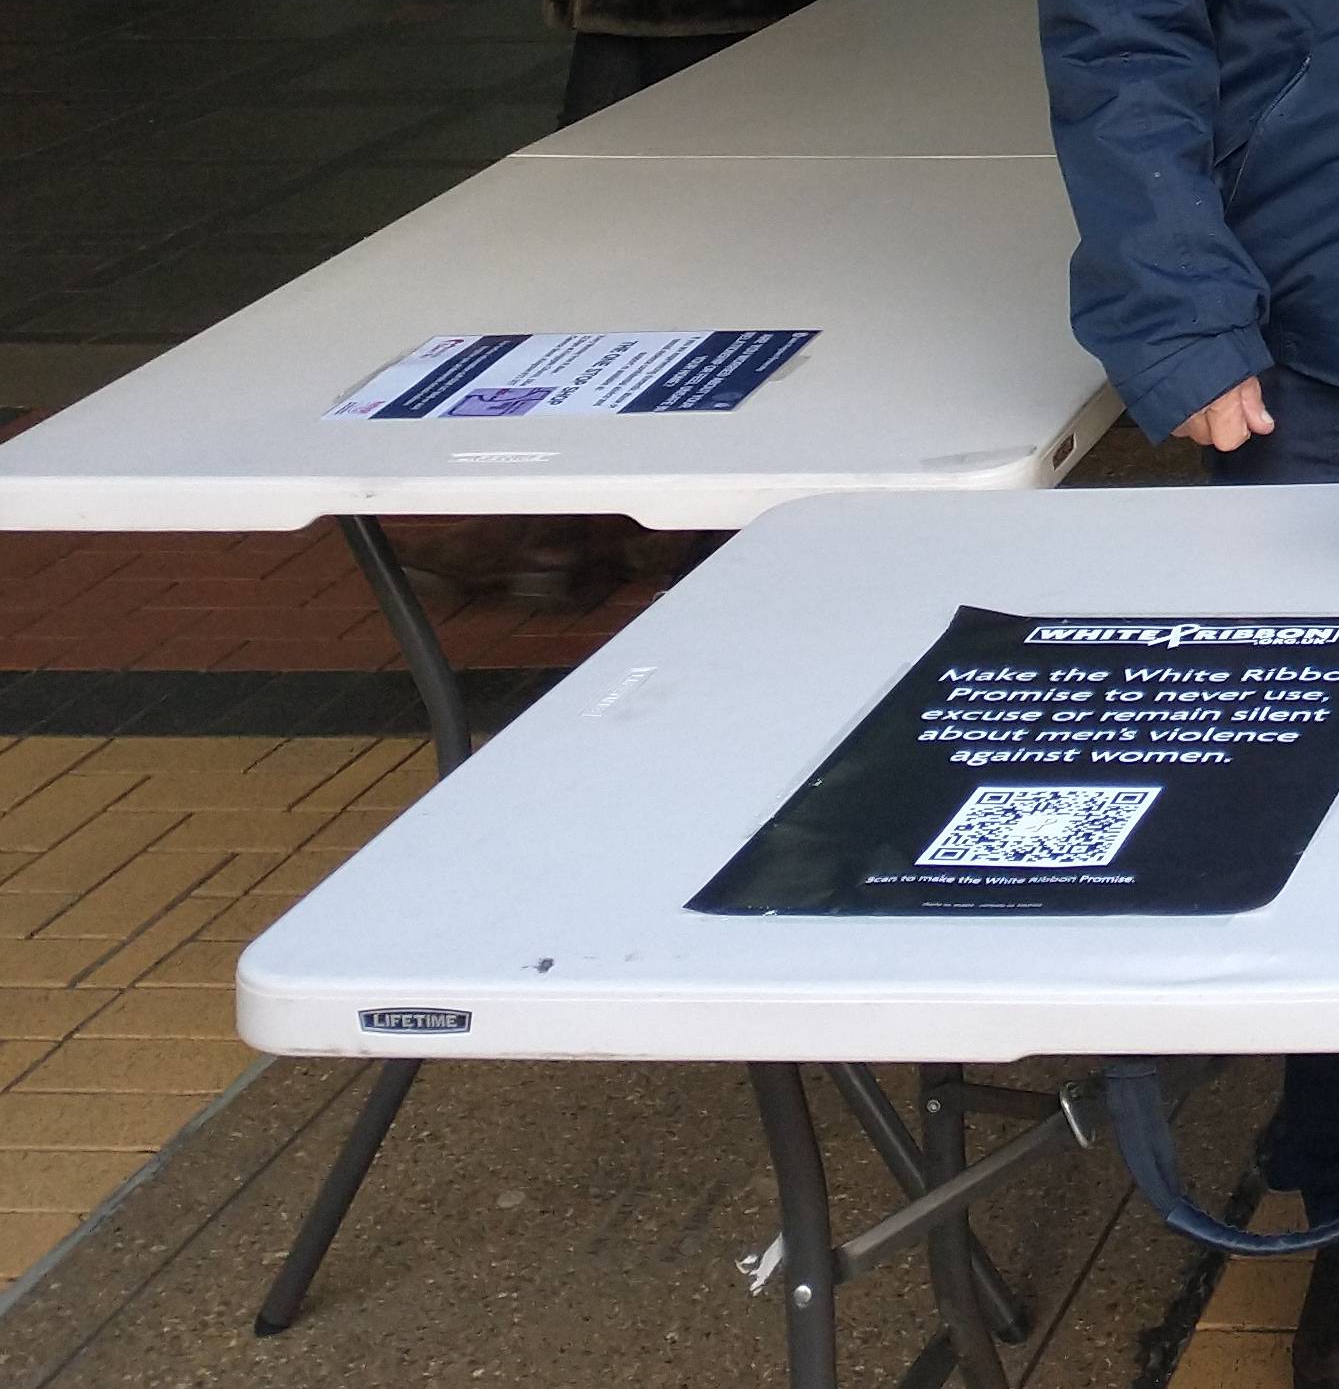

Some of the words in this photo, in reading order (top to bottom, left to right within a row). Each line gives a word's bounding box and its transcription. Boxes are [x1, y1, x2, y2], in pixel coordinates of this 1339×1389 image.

[607, 340, 639, 352] THE
[590, 353, 623, 366] ONE
[568, 368, 605, 385] STOP
[543, 386, 583, 405] SHOP
[1038, 629, 1159, 641] WHITE
[1193, 628, 1333, 642] RIBBON
[938, 669, 1037, 683] Make
[1049, 668, 1105, 683] the
[1124, 668, 1230, 683] White
[946, 688, 1093, 703] Promise
[1105, 688, 1144, 703] to
[1154, 689, 1256, 703] never
[1263, 689, 1331, 705] use,
[920, 709, 1043, 723] excuse
[1051, 710, 1095, 723] or
[1100, 707, 1220, 723] remain
[1230, 706, 1331, 723] silent
[918, 726, 1028, 743] about
[1036, 727, 1137, 743] men's
[1149, 727, 1300, 743] violence
[950, 747, 1082, 766] against
[1090, 749, 1233, 763] women.
[865, 876, 896, 884] Scan
[918, 875, 956, 884] make
[958, 876, 980, 885] the
[985, 877, 1026, 885] White
[373, 1013, 458, 1028] LIFETIME
